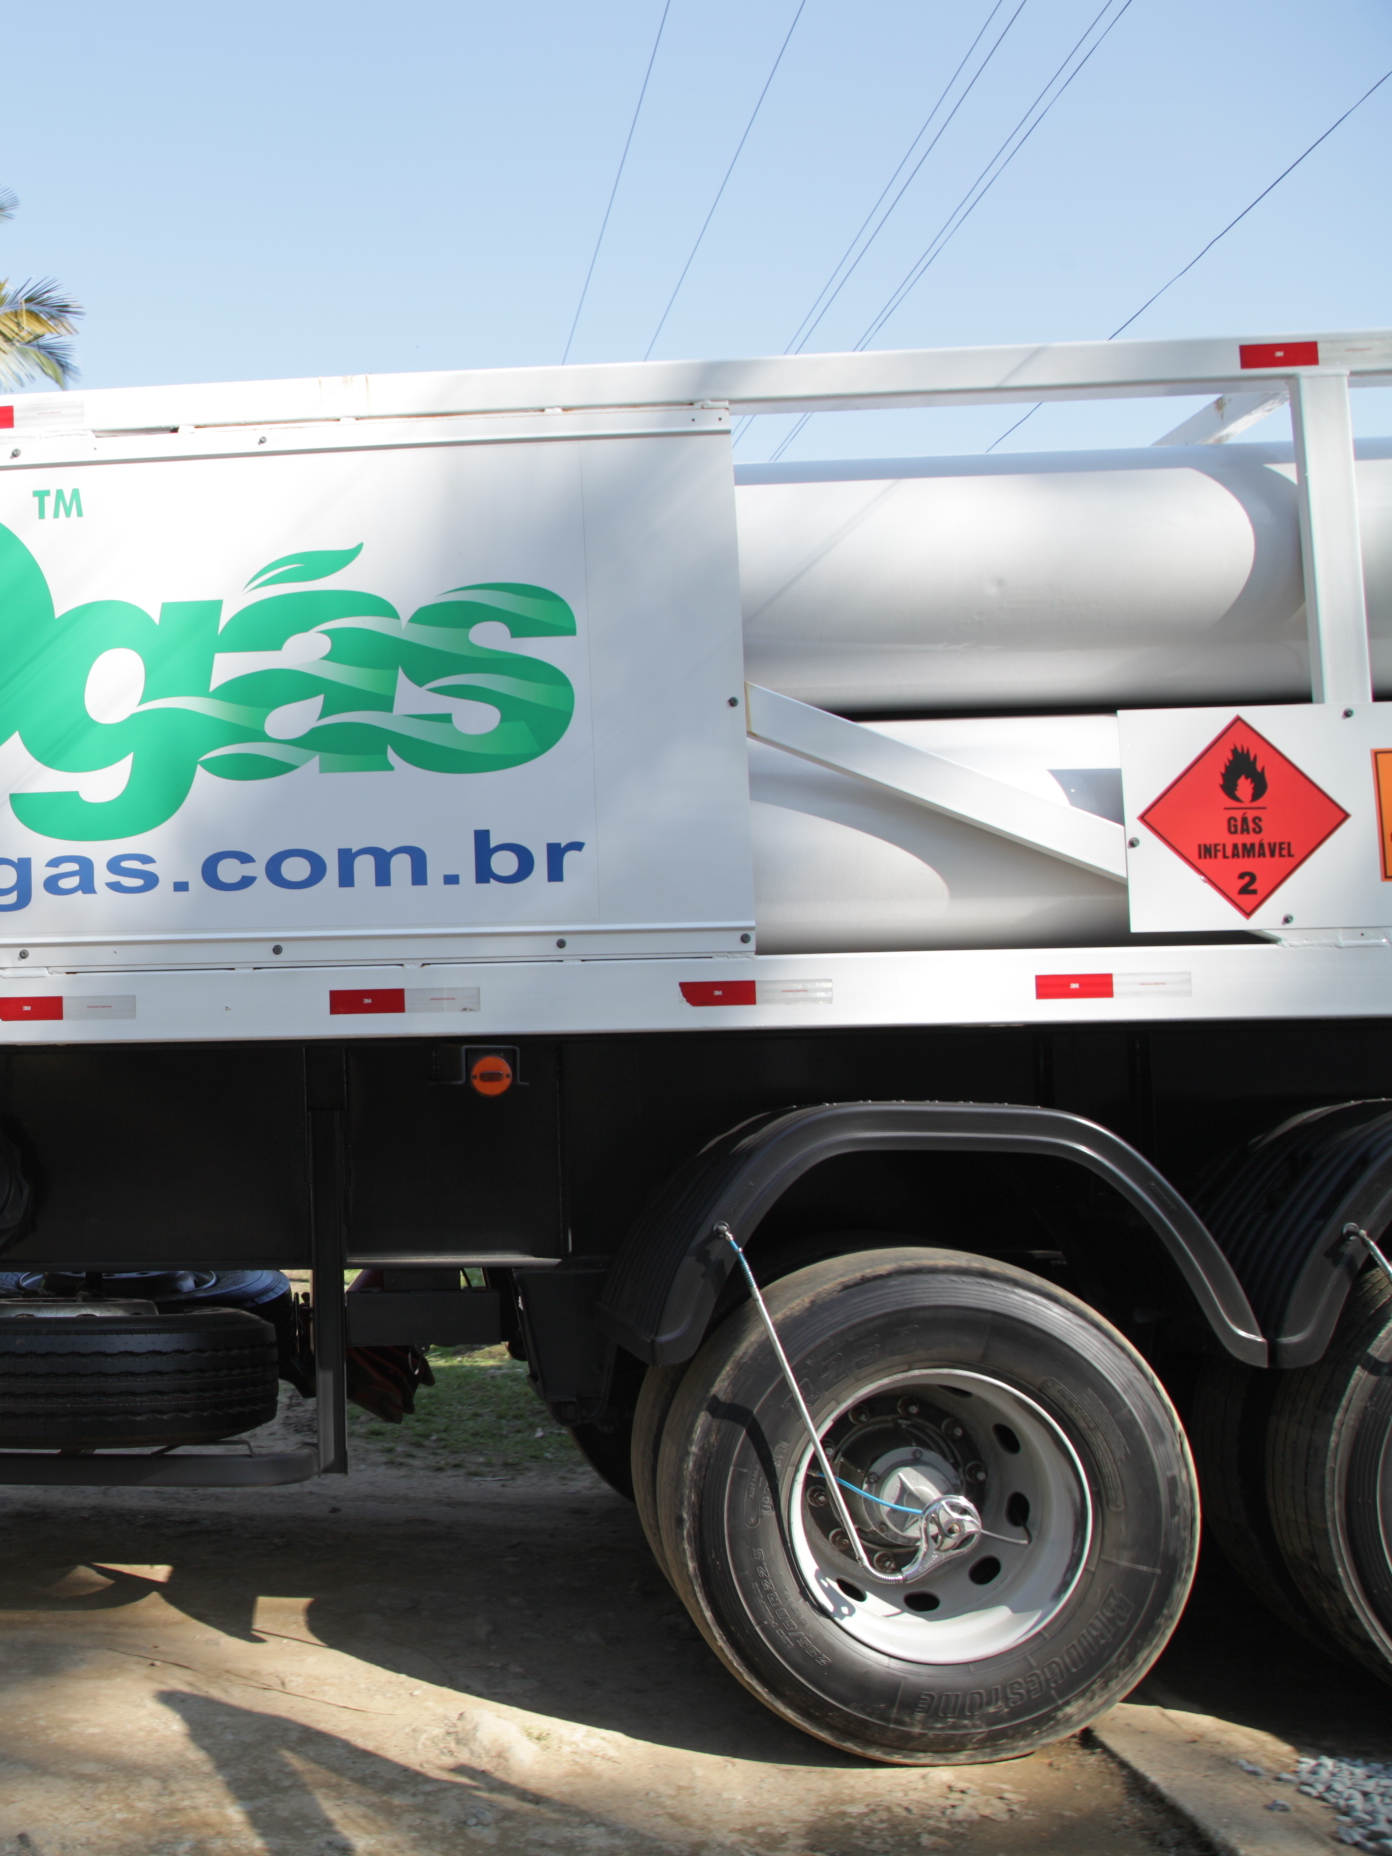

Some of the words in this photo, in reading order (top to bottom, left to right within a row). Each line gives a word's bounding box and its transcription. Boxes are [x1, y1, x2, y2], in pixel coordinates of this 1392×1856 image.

[33, 488, 84, 520] TM
[1227, 812, 1263, 835] GÁS
[1197, 838, 1295, 860] INFLAMÁVEL
[1237, 871, 1258, 895] 2
[914, 1584, 1136, 1717] BRIDGESTONE
